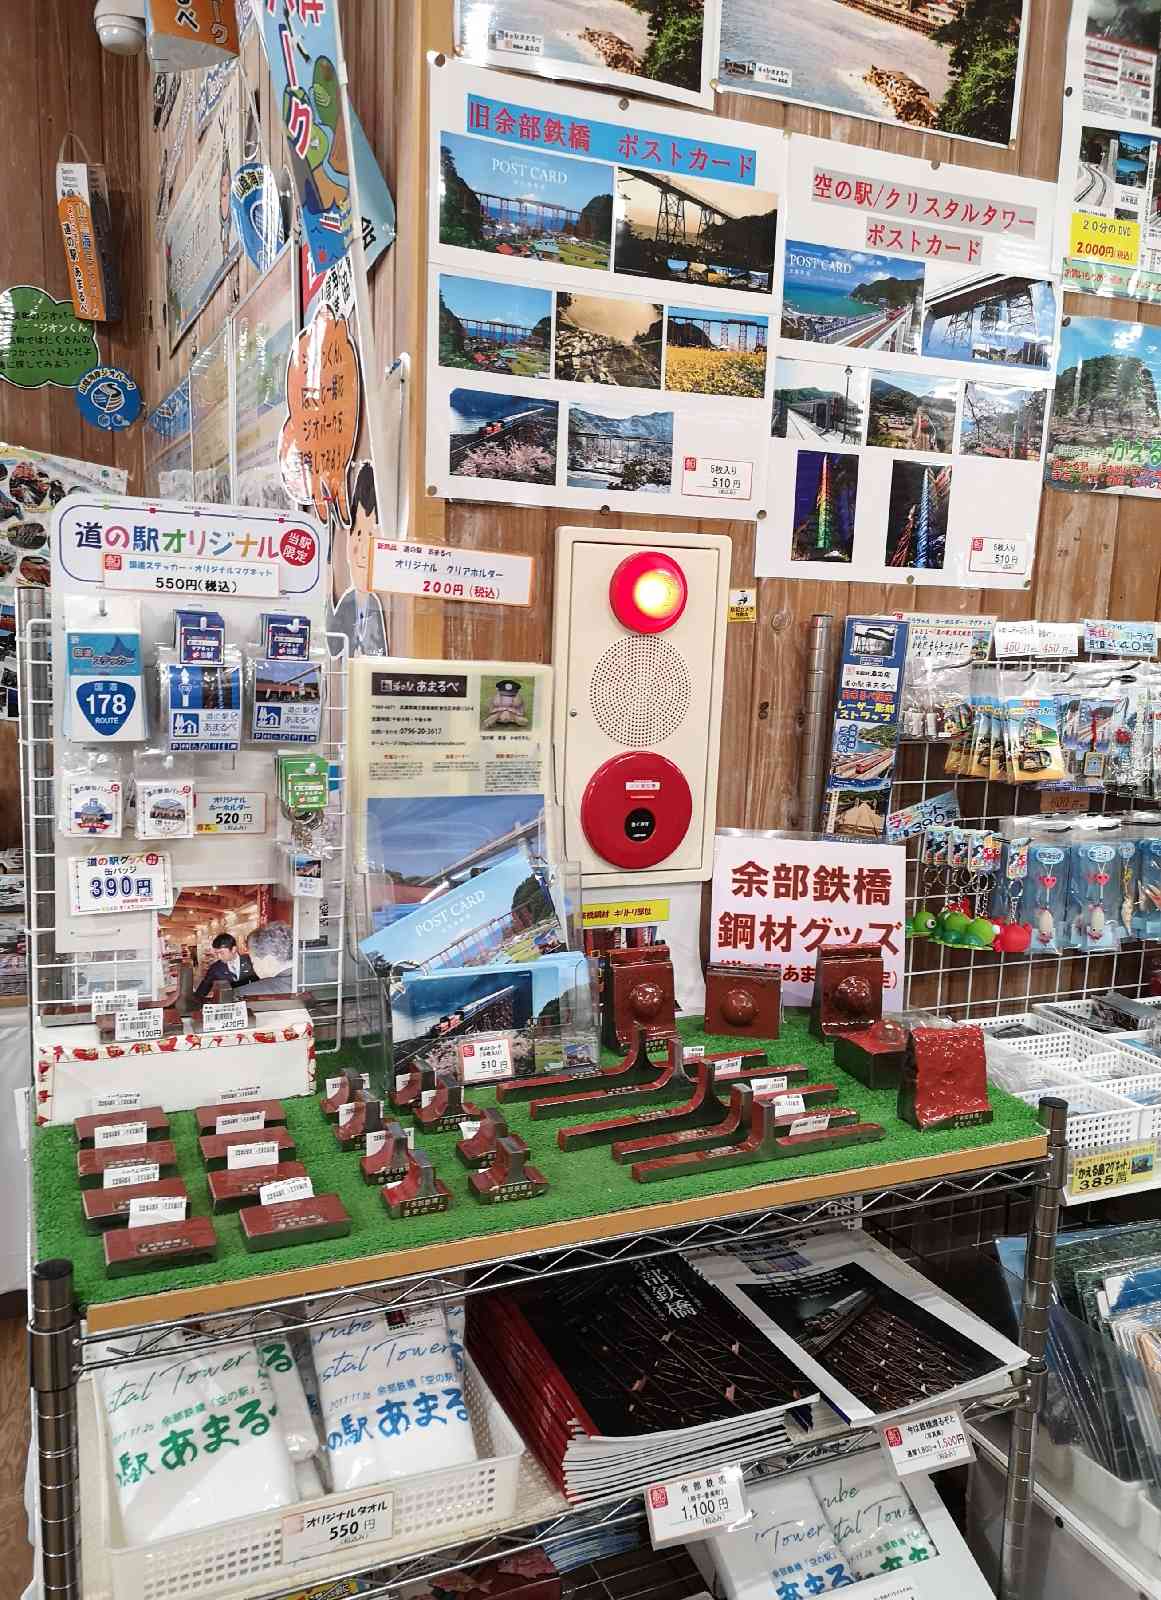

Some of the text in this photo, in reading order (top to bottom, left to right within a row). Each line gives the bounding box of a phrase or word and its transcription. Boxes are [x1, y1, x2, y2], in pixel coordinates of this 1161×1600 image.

[469, 101, 753, 179] 旧余部鉄橋 ポストカード
[491, 158, 568, 184] POST CARD
[813, 174, 1036, 229] 空の駅/クリスタルタワー
[866, 224, 982, 261] ポストカード
[789, 254, 851, 274] POST CARD
[712, 477, 741, 489] 510円
[75, 521, 280, 560] 道の駅オリジナル
[287, 531, 312, 549] 当駅
[282, 545, 308, 562] 限定
[994, 554, 1019, 564] 510円
[395, 559, 504, 578] オリジナル クリアホルダー
[156, 577, 239, 594] 550円(税込)
[416, 681, 460, 693] あまるべ
[86, 693, 127, 715] 178
[95, 717, 119, 725] ROUTE
[215, 812, 254, 825] 520円
[90, 875, 153, 898] 390円
[731, 861, 892, 906] 余部鉄橋
[415, 889, 487, 937] POST CARD
[717, 911, 904, 955] 鋼材グッズ
[373, 1333, 451, 1373] Tower
[160, 1350, 251, 1388] Tower
[306, 1501, 388, 1529] オリジナルタオル
[681, 1497, 729, 1521] 1,100円
[329, 1518, 376, 1541] 550円
[760, 1519, 826, 1553] Tower
